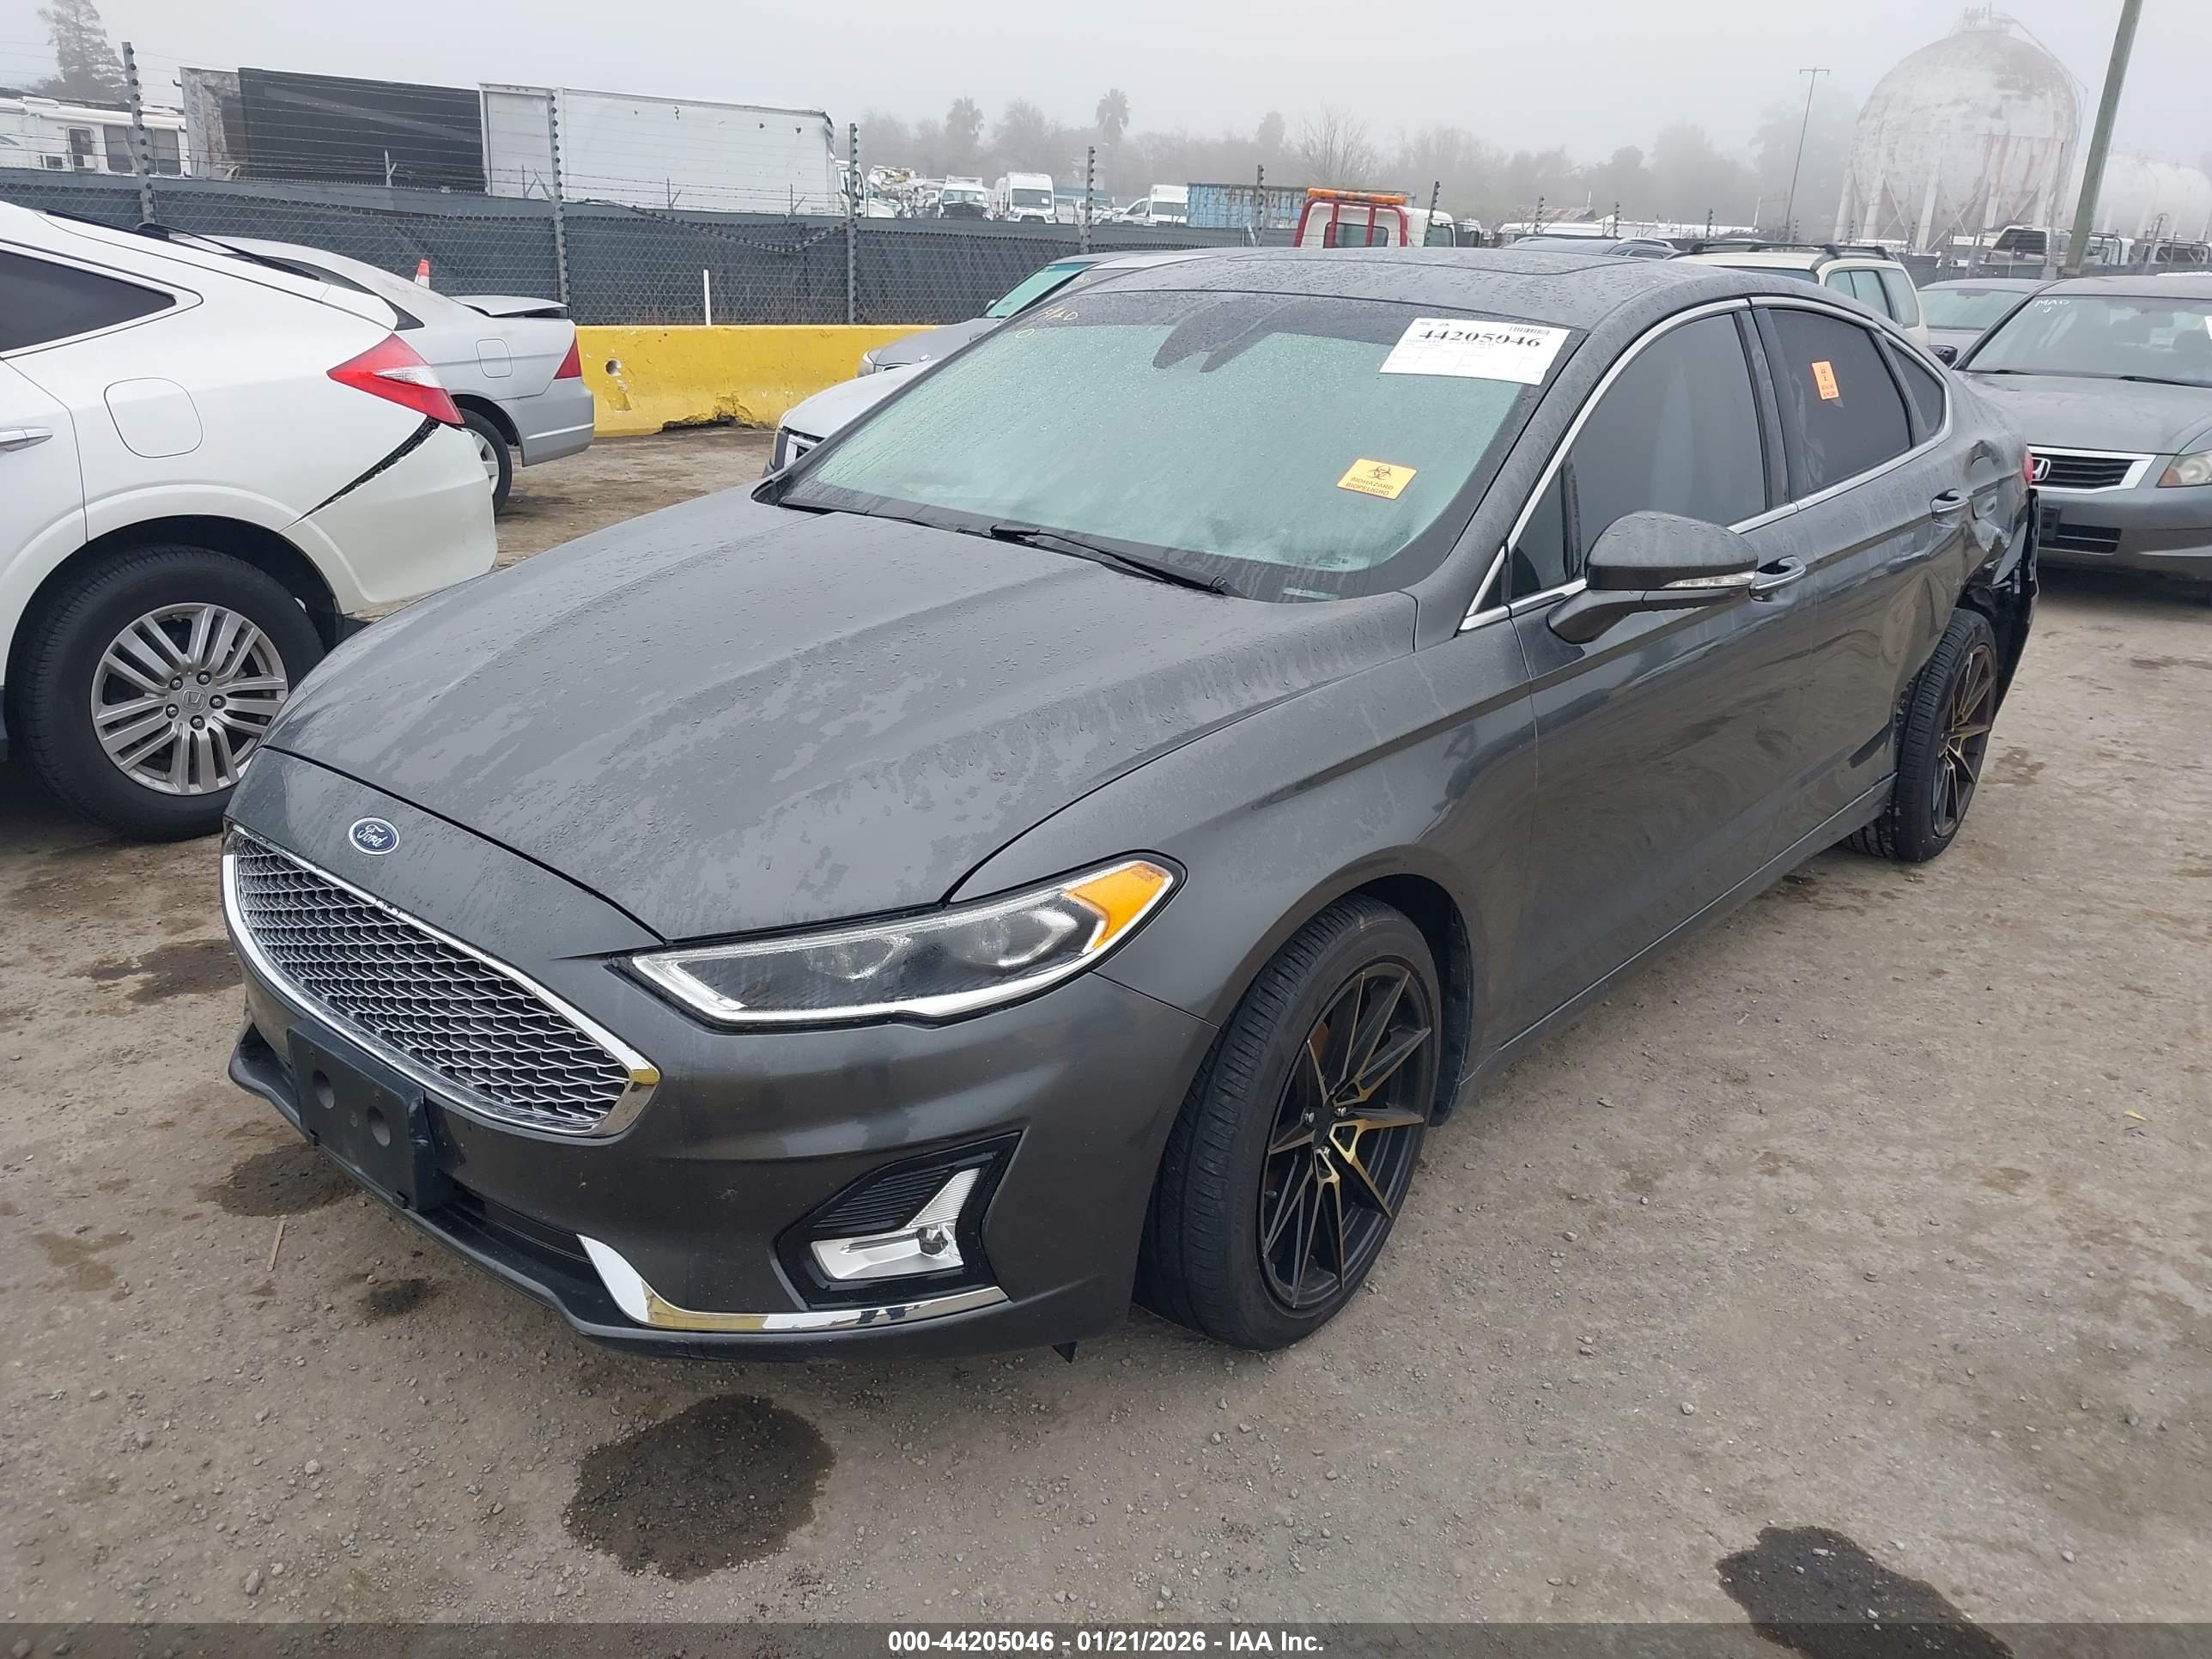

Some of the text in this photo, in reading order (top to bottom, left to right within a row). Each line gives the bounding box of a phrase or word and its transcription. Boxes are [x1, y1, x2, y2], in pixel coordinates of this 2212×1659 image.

[1346, 483, 1389, 495] BIOPELIGRO
[1350, 477, 1395, 490] BIOHAZARD
[357, 824, 388, 848] Ford
